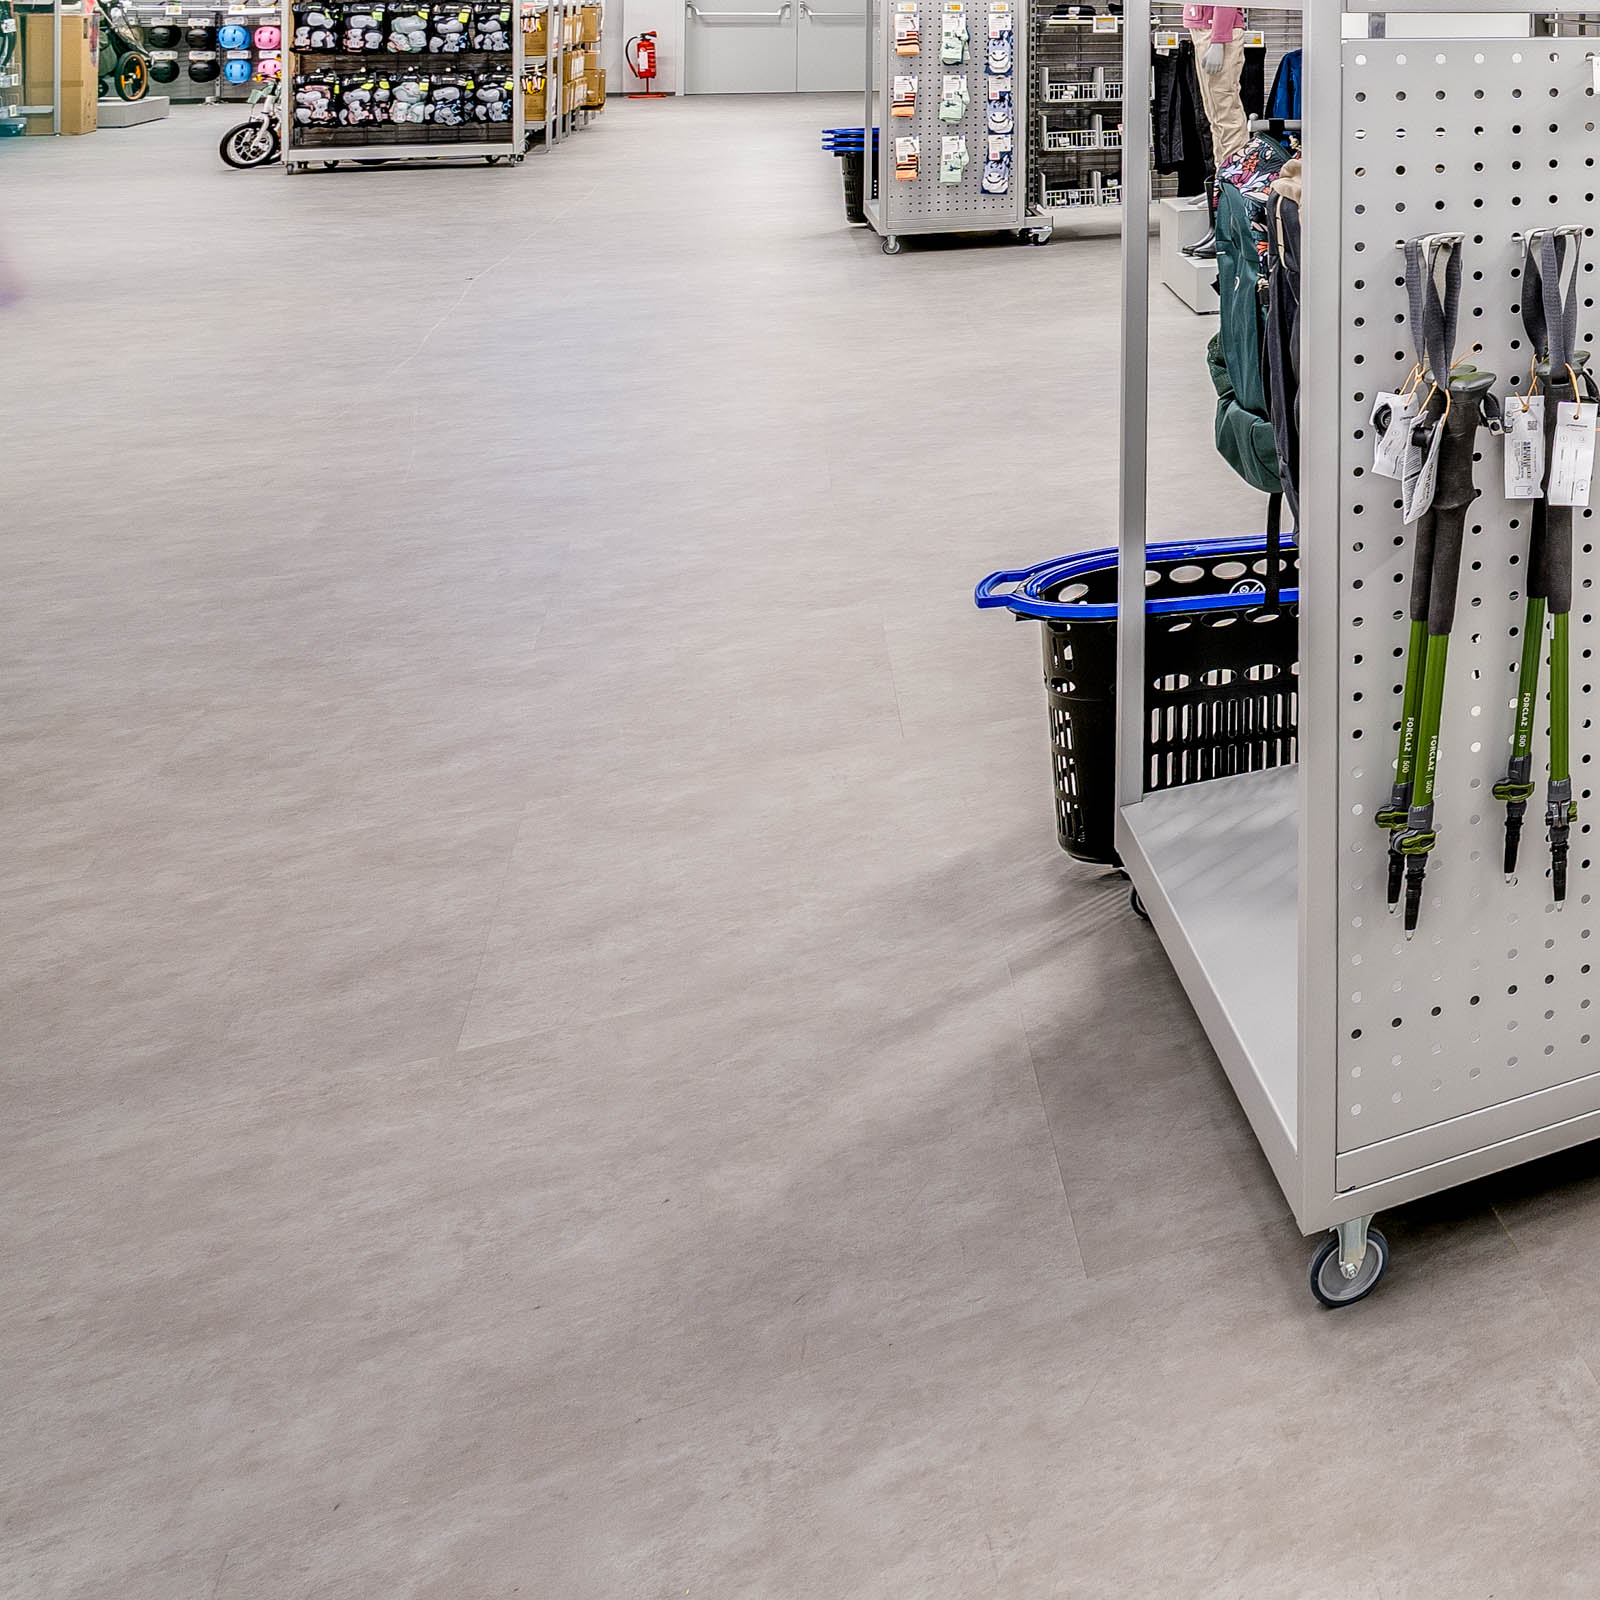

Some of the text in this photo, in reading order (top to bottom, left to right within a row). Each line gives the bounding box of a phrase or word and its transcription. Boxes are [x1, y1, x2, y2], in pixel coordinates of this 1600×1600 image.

[1401, 716, 1415, 774] FORCLAZ 500
[1518, 692, 1531, 748] FORCLAZ 500
[1427, 735, 1438, 772] FORCLAZ
